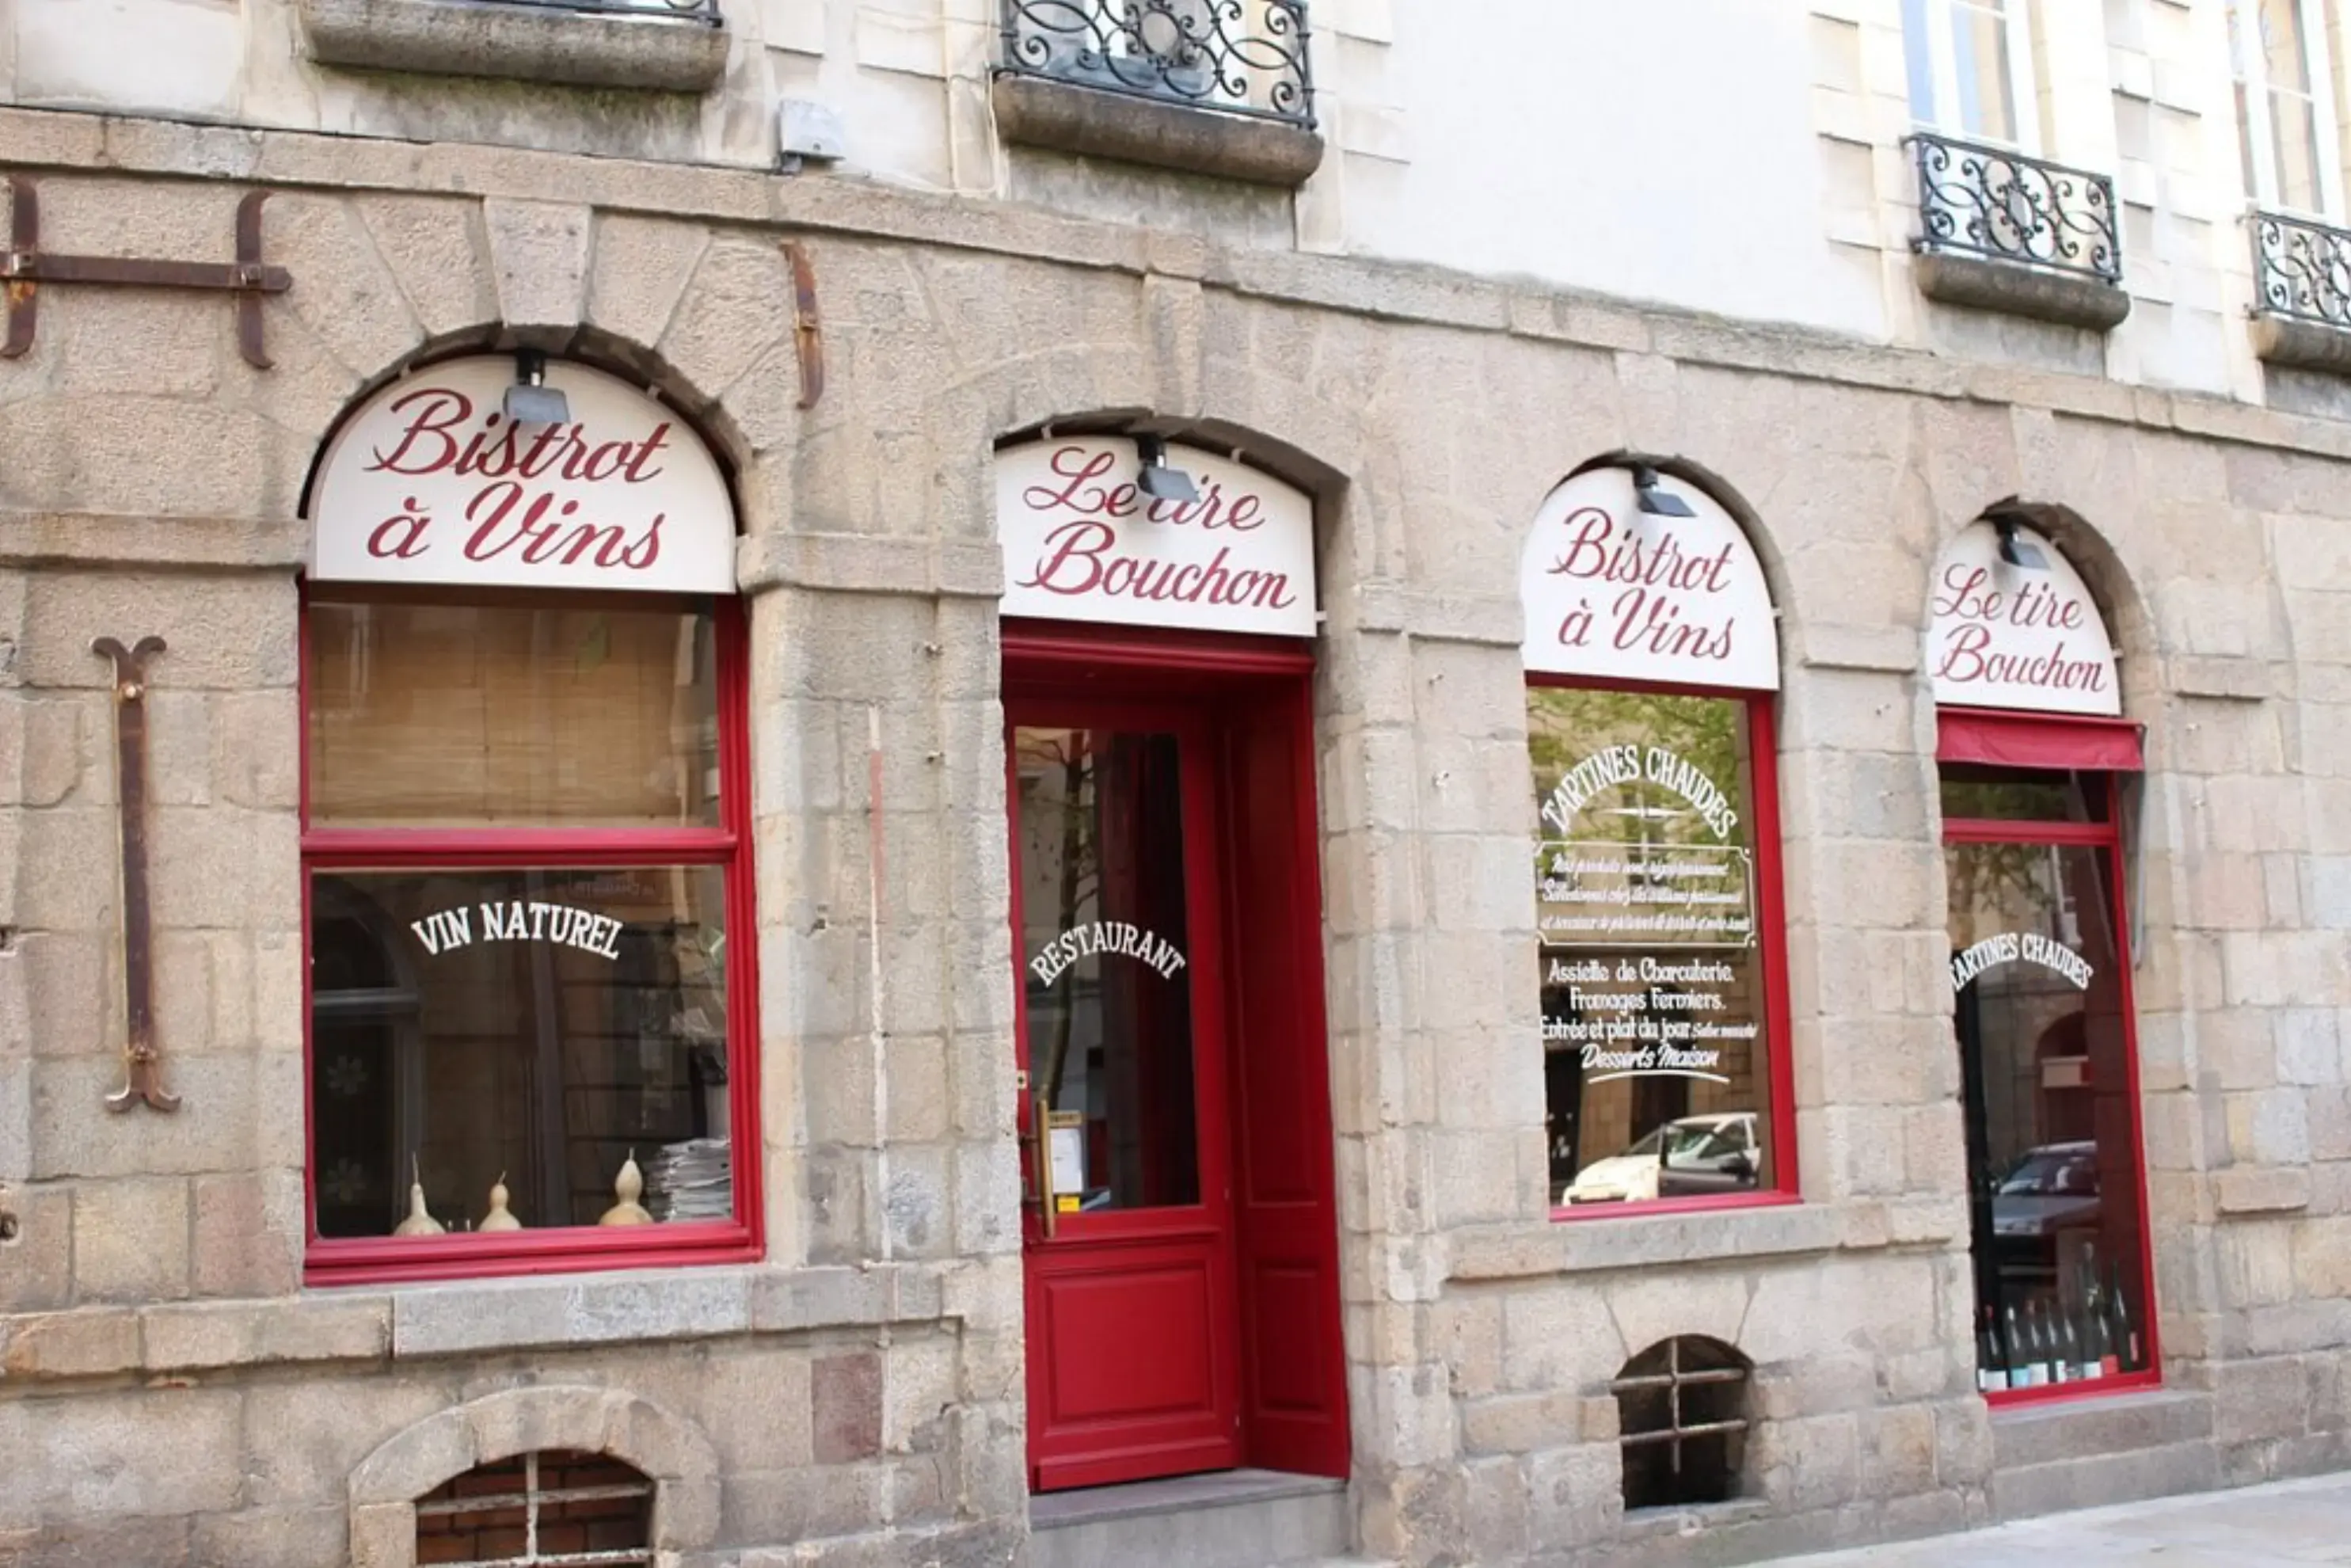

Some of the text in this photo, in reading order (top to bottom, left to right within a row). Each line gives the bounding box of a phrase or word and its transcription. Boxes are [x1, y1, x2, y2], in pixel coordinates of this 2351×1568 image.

[362, 388, 671, 483] Bistrot
[1022, 446, 1139, 517] Le
[367, 481, 666, 570] à Vins
[1546, 507, 1734, 592] Bistrot
[1014, 521, 1297, 609] Bouchon
[1932, 562, 2083, 630] Le tire
[1558, 588, 1735, 660] à Vins
[1931, 622, 2107, 694] Bouchon
[1541, 744, 1738, 839] TARTINES CHAUDES
[410, 900, 624, 961] VIN NATUREL
[1030, 920, 1186, 988] RESTAURANT
[2022, 932, 2094, 991] CHAUDES
[1546, 957, 1609, 983] Assiette
[1615, 957, 1638, 982] de
[1569, 987, 1647, 1017] Fromages
[1580, 1042, 1720, 1070] Desserts Maison
[1589, 1017, 1604, 1041] et
[1606, 1015, 1637, 1045] plat
[1638, 1015, 1658, 1040] du
[1660, 1018, 1691, 1044] jour
